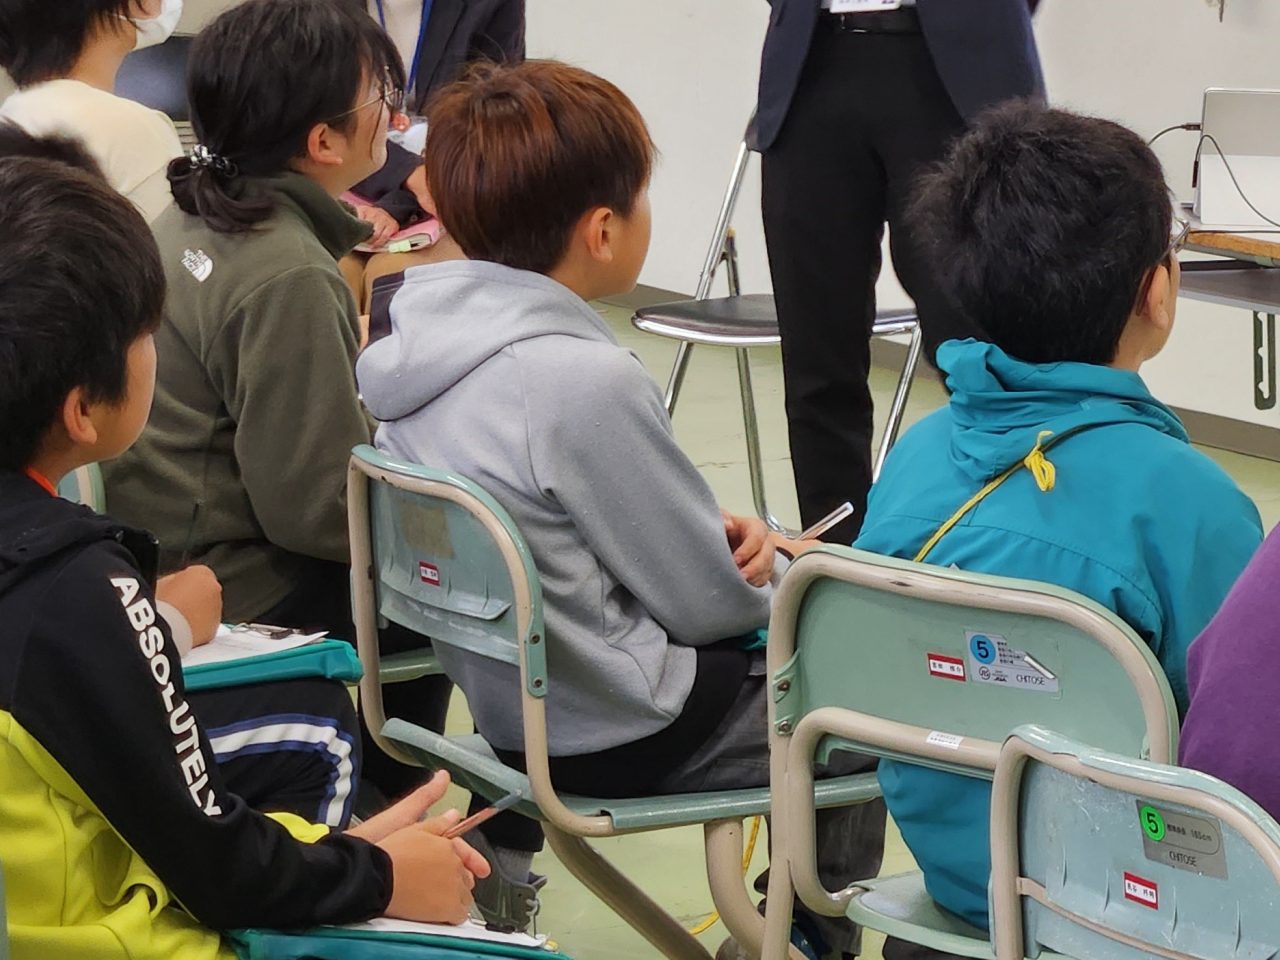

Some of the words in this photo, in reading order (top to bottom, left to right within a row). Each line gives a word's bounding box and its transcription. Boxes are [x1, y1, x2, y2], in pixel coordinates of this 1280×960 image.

[976, 640, 990, 659] 5
[109, 575, 224, 817] ABSOLUTELY
[1146, 812, 1159, 834] 5
